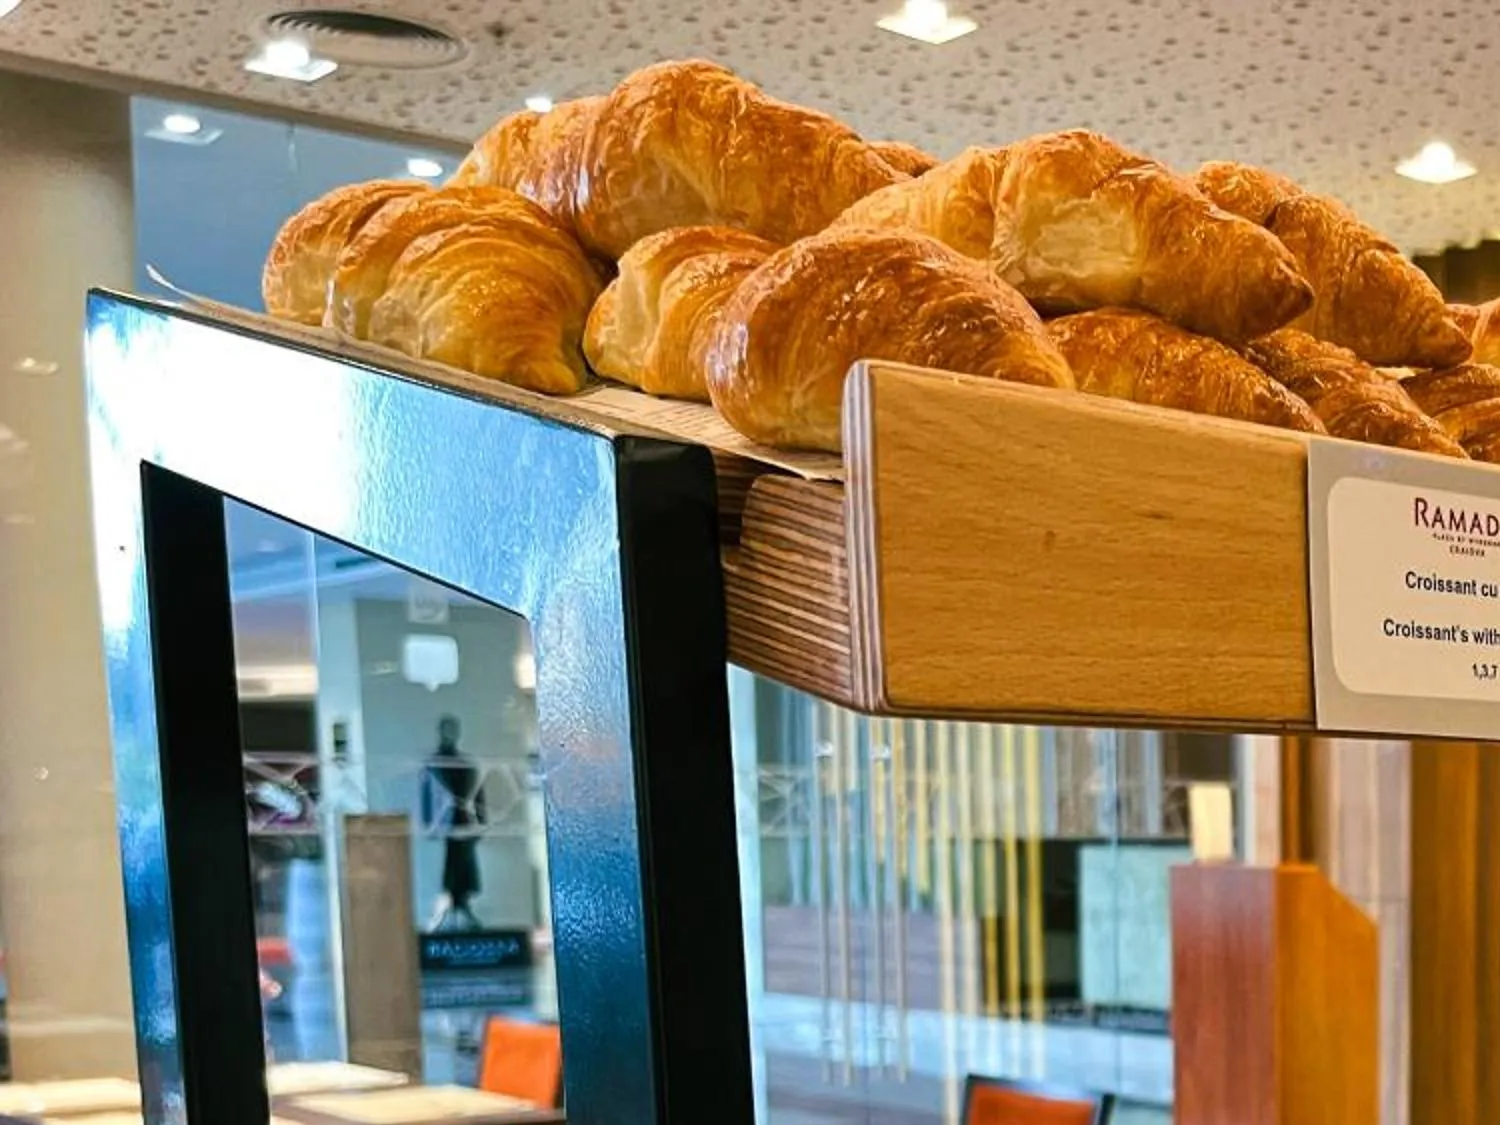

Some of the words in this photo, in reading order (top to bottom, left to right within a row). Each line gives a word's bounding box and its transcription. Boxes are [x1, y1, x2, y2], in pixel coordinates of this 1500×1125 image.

[1405, 570, 1477, 597] Croissant
[1480, 581, 1499, 599] cu
[1383, 617, 1469, 643] Croissant's
